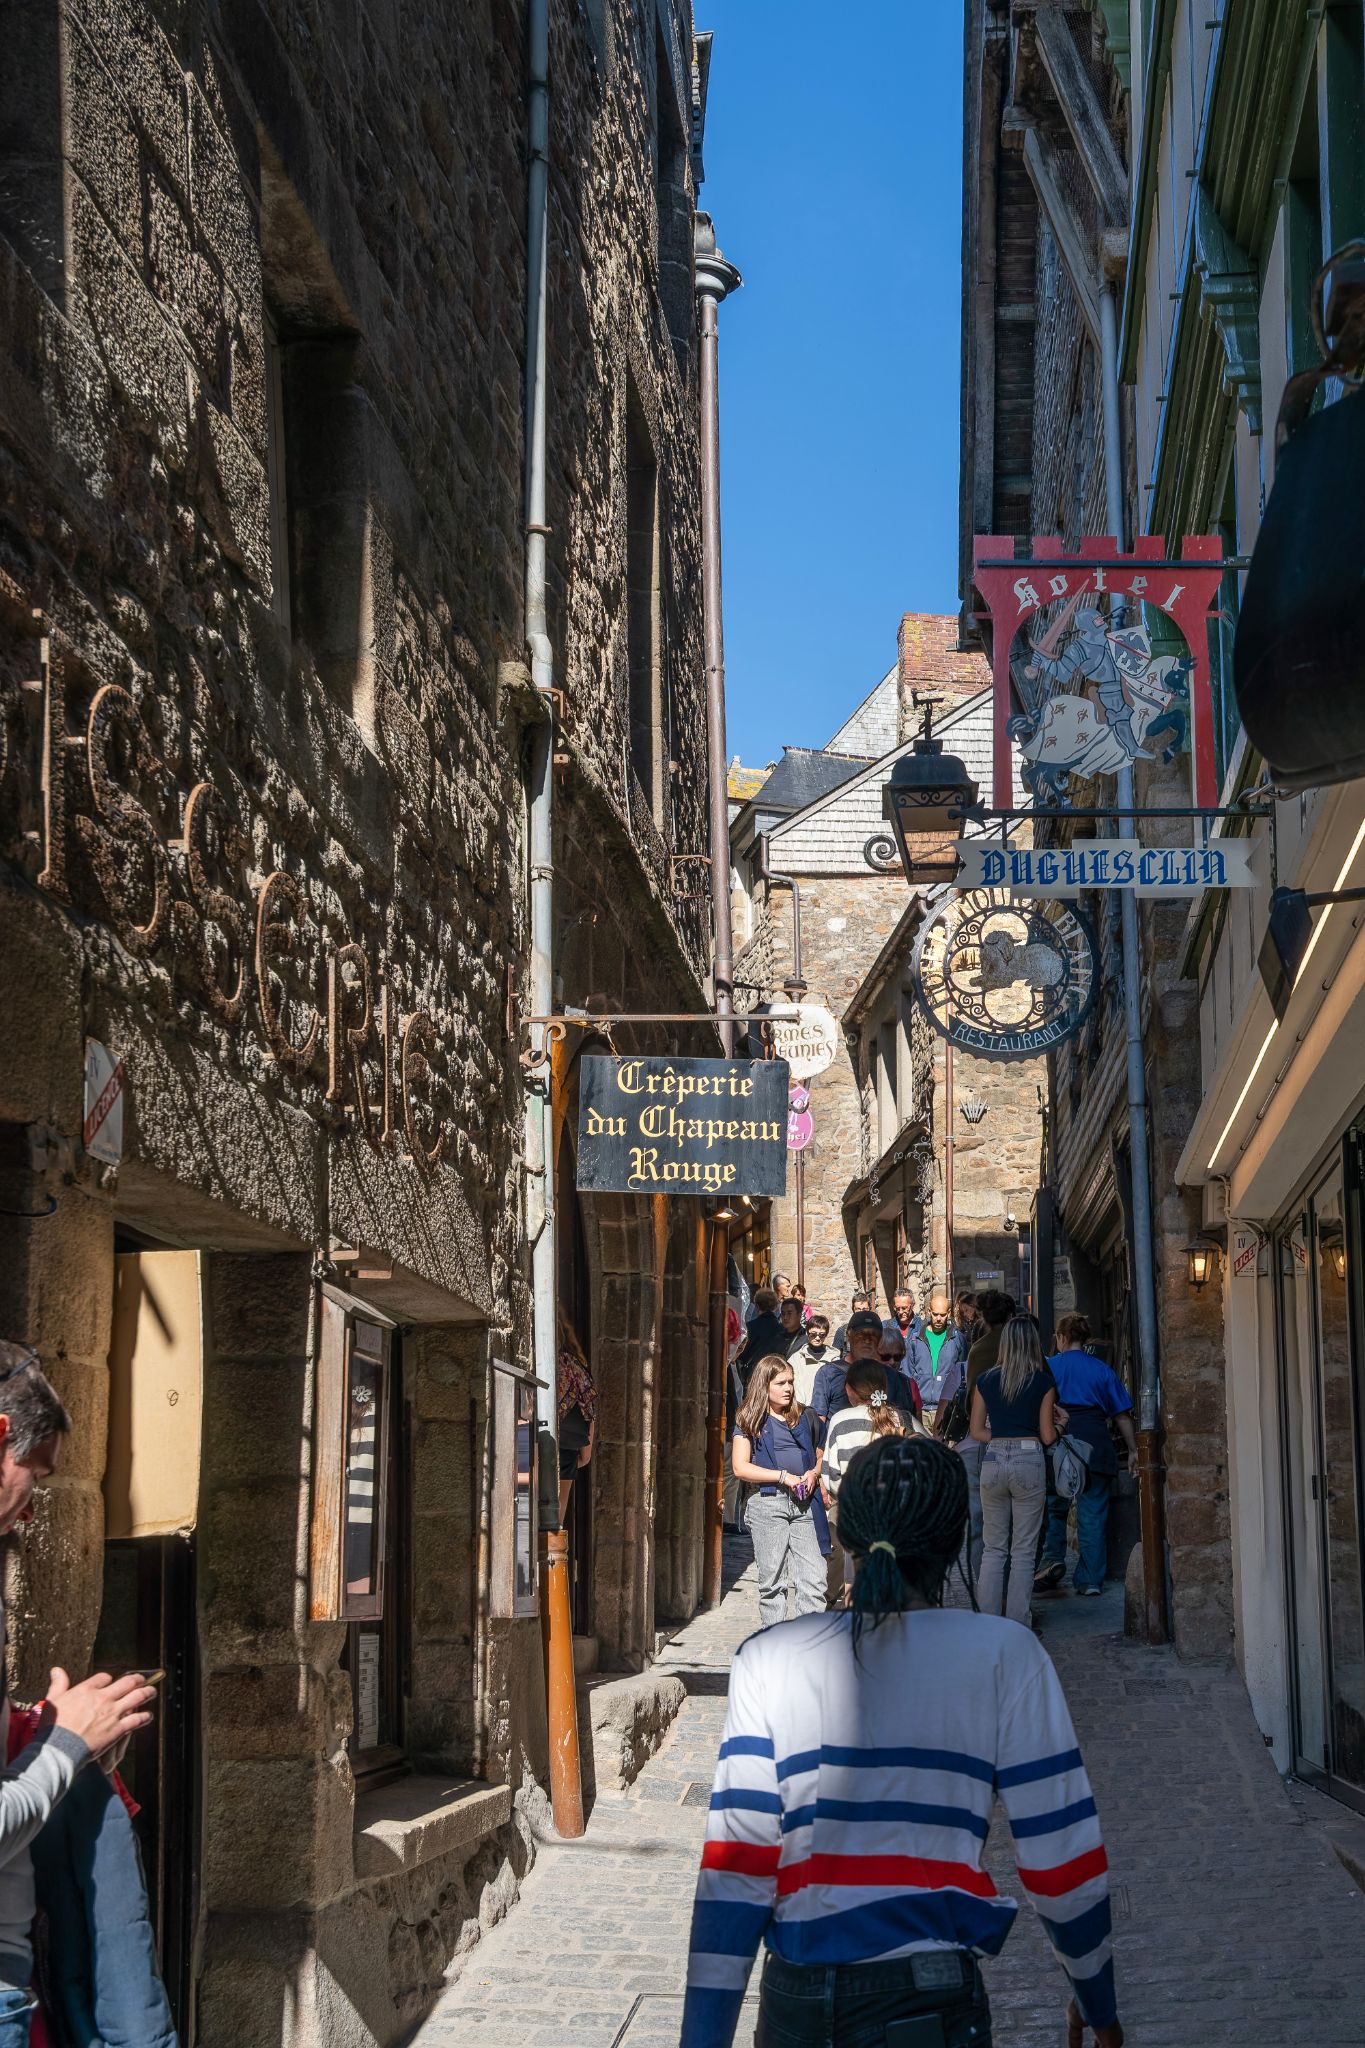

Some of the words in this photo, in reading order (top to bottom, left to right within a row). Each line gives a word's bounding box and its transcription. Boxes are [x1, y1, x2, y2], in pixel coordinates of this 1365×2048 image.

[979, 849, 1227, 886] DUGUESCLIN
[1052, 910, 1093, 1004] BLANC
[774, 1024, 824, 1043] RMES
[779, 1040, 833, 1061] EUNIES
[954, 1020, 1064, 1051] RESTAURANT
[617, 1061, 754, 1104] Crêperie
[586, 1107, 628, 1137] du
[638, 1104, 781, 1149] Chapeau
[627, 1147, 737, 1193] Rouge
[1237, 1238, 1246, 1249] IV
